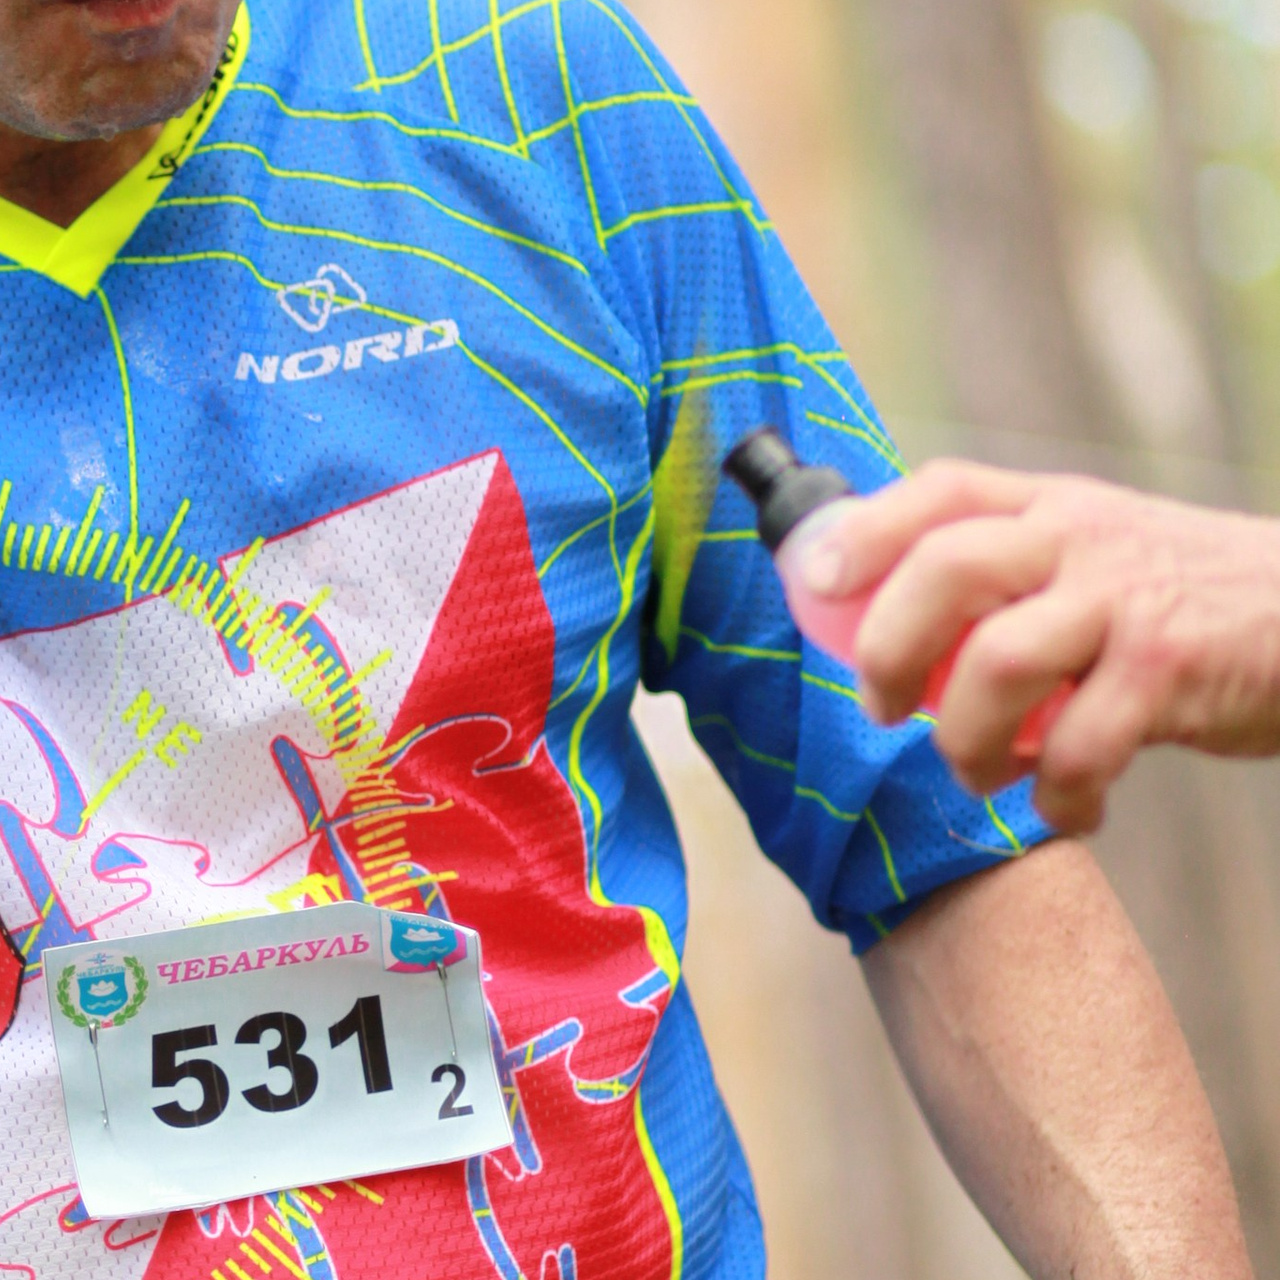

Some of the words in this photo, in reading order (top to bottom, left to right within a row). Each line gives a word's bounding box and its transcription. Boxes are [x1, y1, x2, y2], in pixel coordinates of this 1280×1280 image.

[234, 318, 460, 384] NORD
[122, 688, 204, 769] NE
[157, 933, 370, 985] ЧЕБАРКУЛЬ
[151, 994, 394, 1129] 531
[431, 1063, 475, 1121] 2
